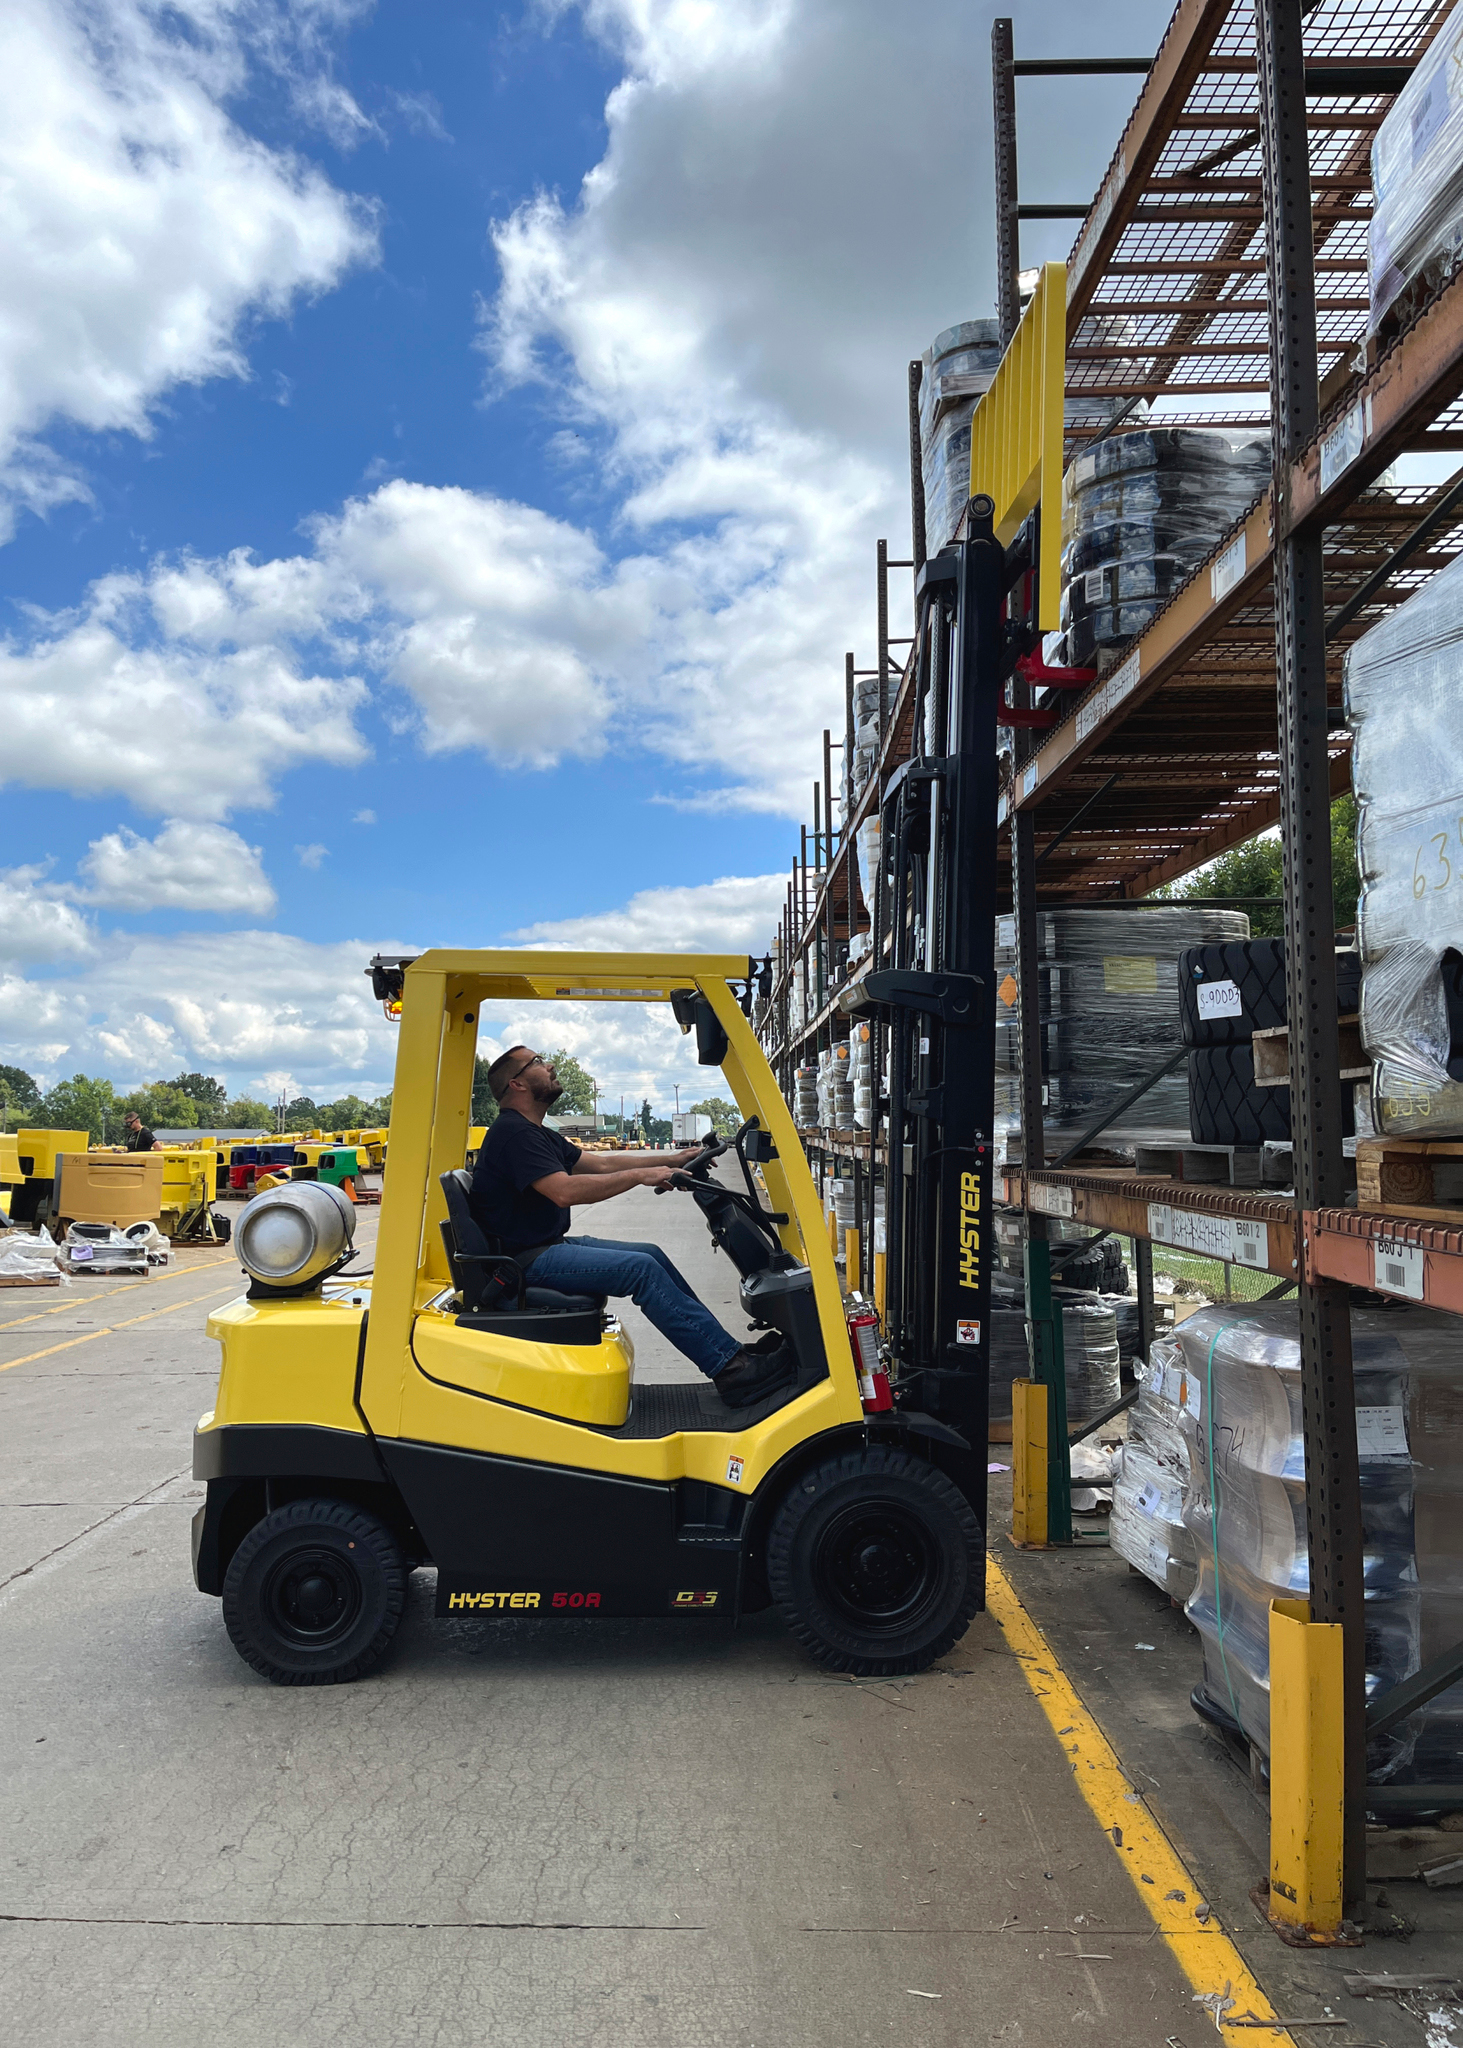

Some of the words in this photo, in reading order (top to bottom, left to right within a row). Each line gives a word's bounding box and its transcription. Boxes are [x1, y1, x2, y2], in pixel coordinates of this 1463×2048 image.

[959, 1171, 980, 1290] HYSTER
[1255, 1224, 1260, 1239] 2
[448, 1592, 542, 1609] HYSTER
[551, 1592, 602, 1608] 50A
